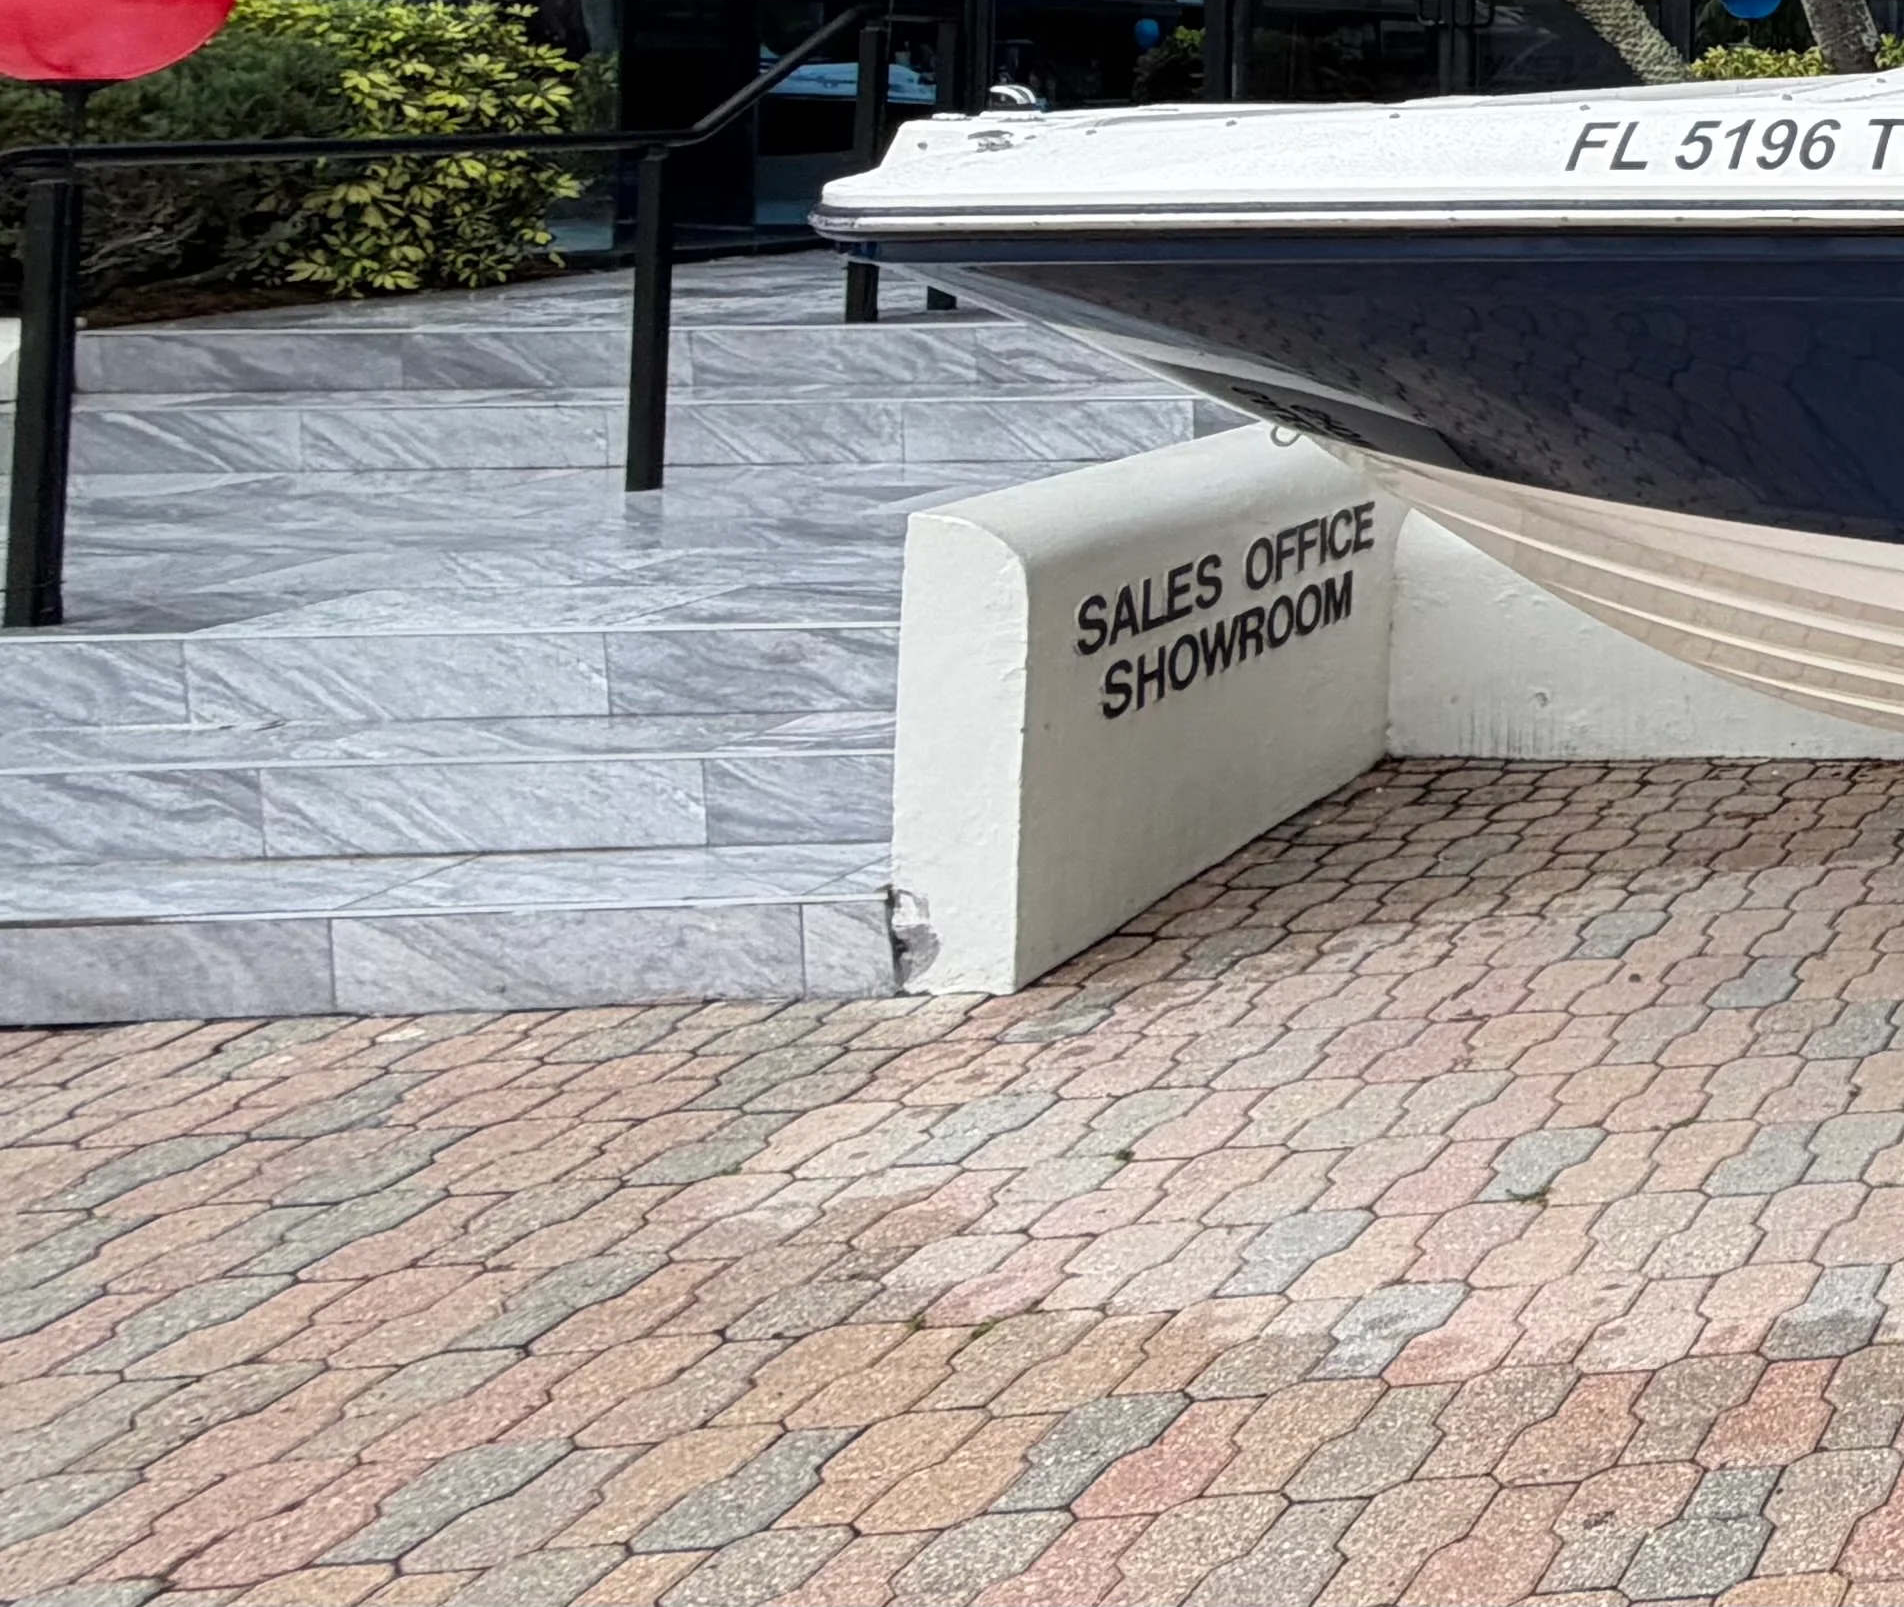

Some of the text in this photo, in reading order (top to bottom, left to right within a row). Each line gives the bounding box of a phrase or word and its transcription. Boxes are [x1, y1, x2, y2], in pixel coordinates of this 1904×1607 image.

[1565, 120, 1649, 172] FL
[1675, 118, 1842, 171] 5196
[1075, 500, 1376, 657] SALES OFFICE
[1102, 569, 1354, 720] SHOWROOM
